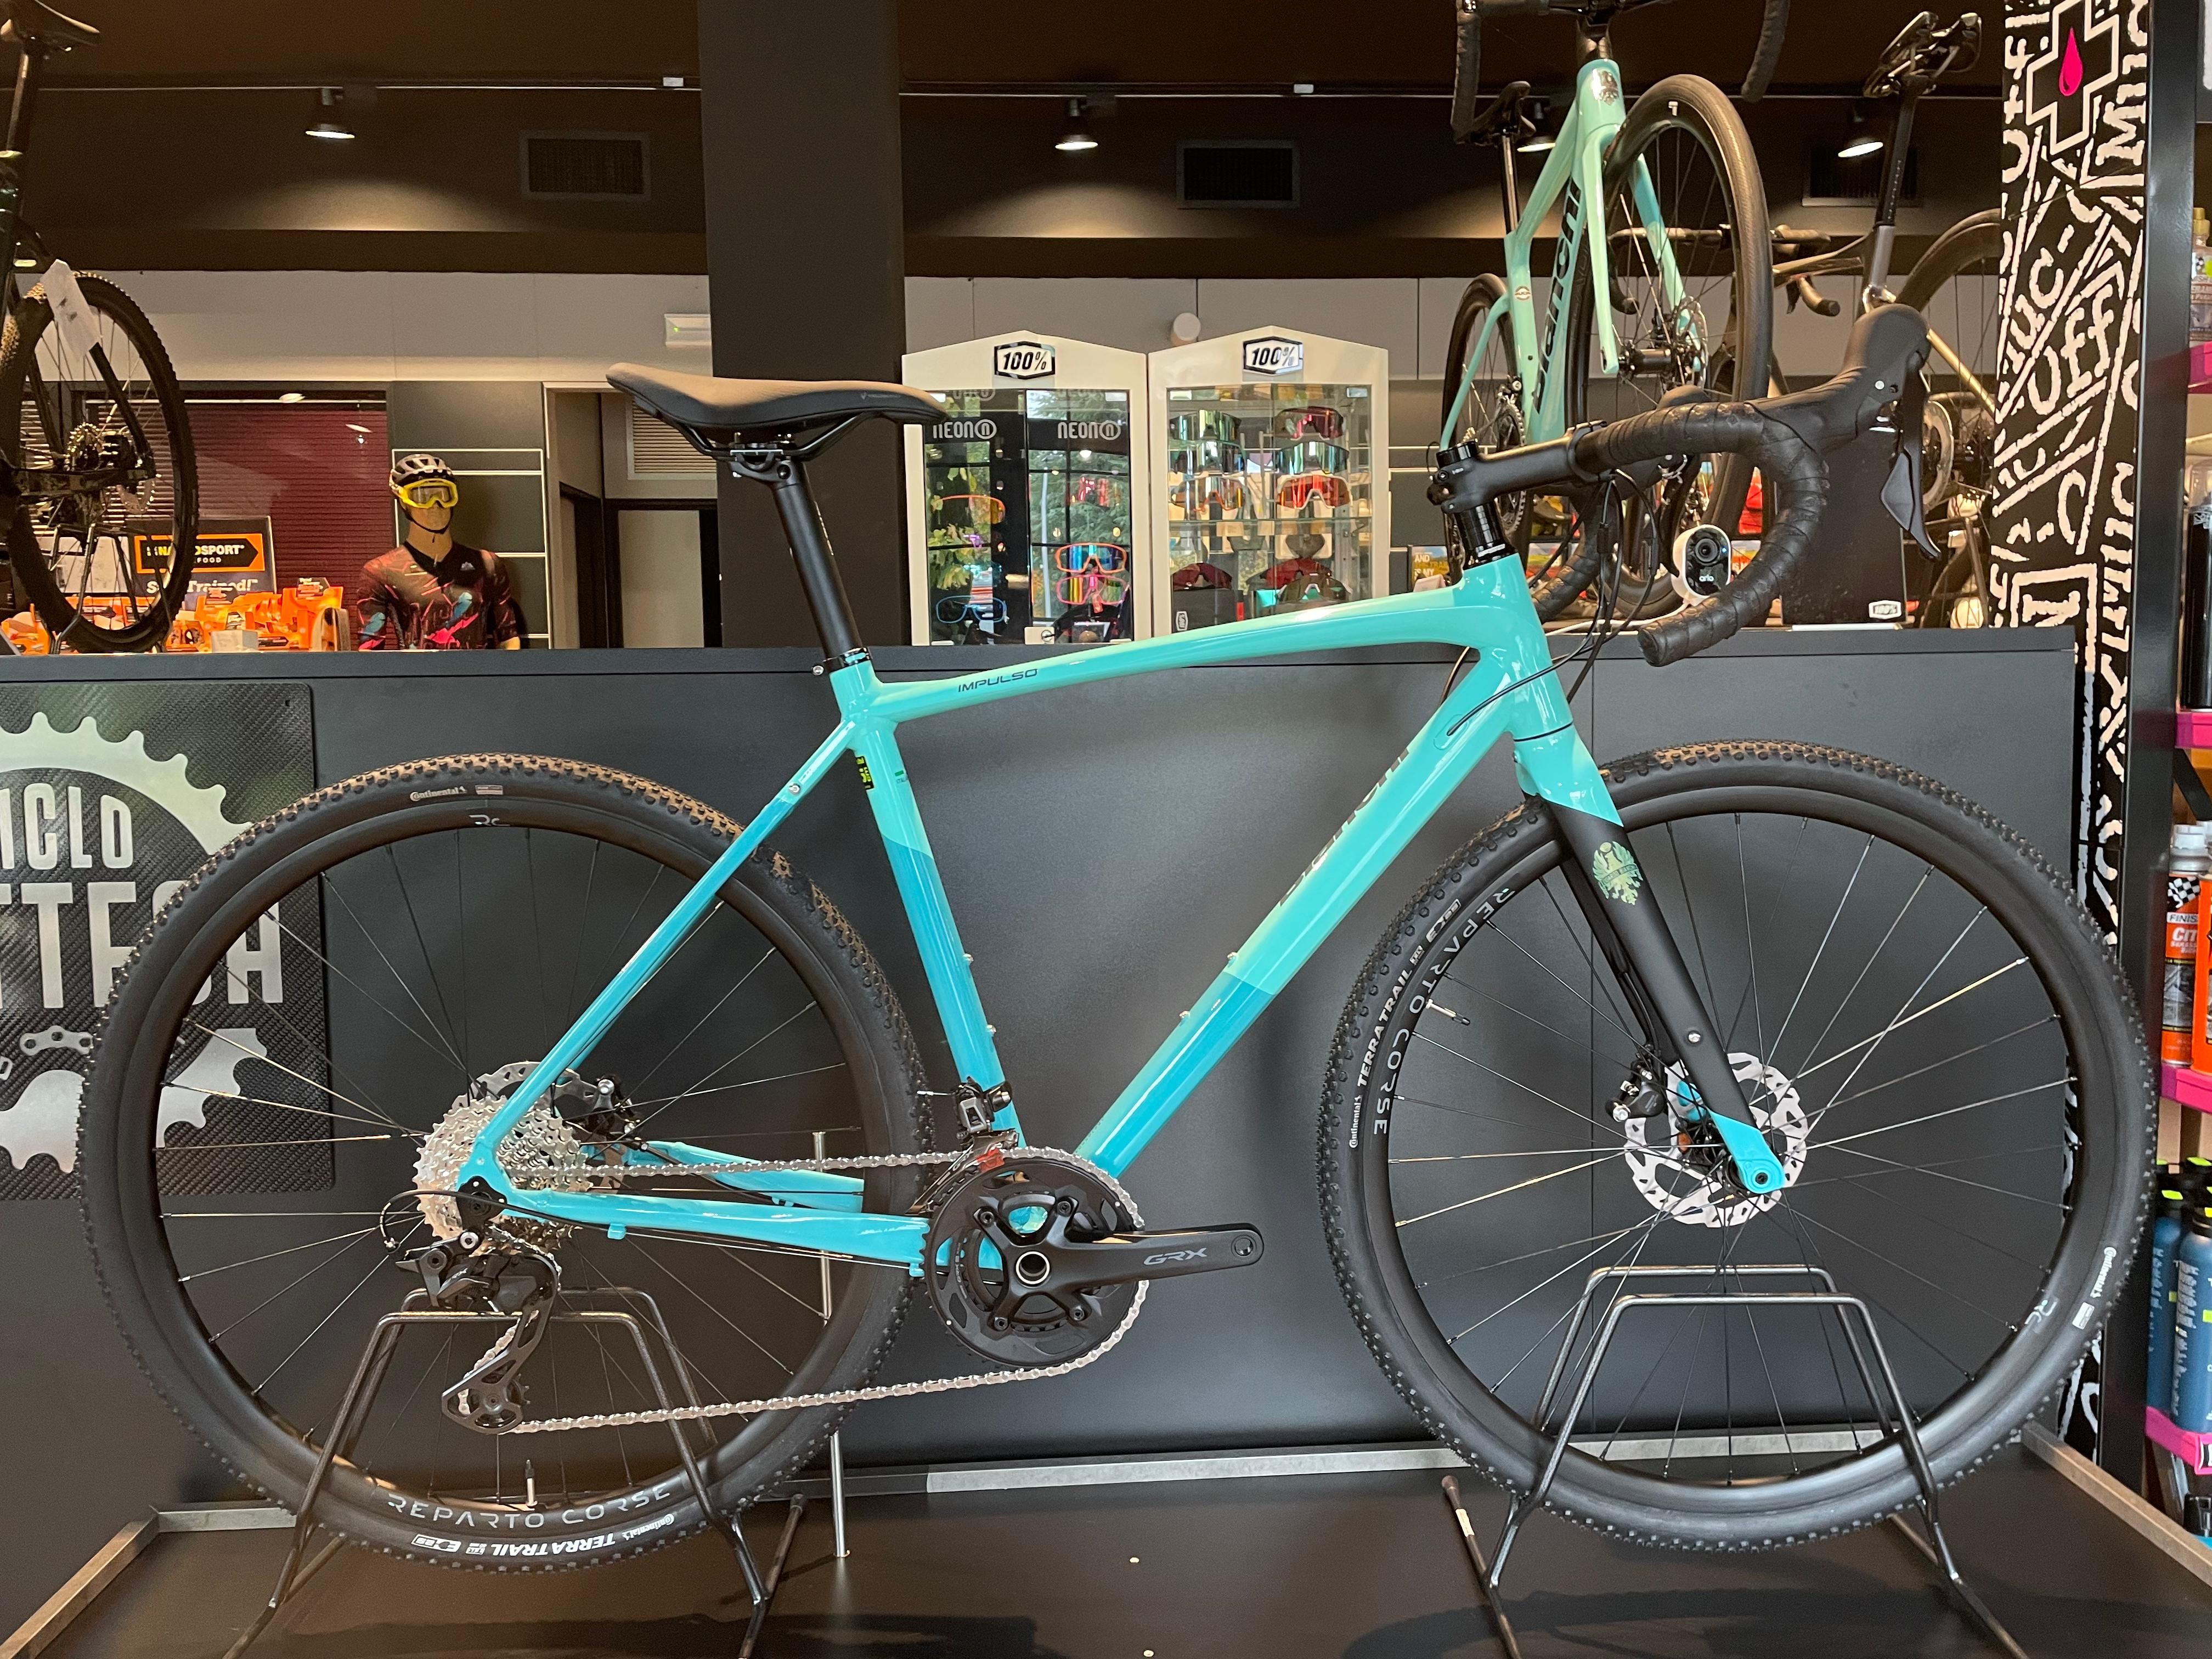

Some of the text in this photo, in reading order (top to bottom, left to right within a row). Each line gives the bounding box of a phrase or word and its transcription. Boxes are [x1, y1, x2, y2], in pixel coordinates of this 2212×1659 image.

[1003, 352, 1047, 370] 100%
[1251, 347, 1296, 367] 100%
[958, 668, 1039, 692] IMPULSO
[410, 786, 460, 802] Continental
[1373, 888, 1516, 1135] REPARTO CORSE
[1349, 1101, 1361, 1149] Continental
[1143, 1247, 1207, 1266] GRX
[387, 1483, 671, 1529] REPARTO CORSE
